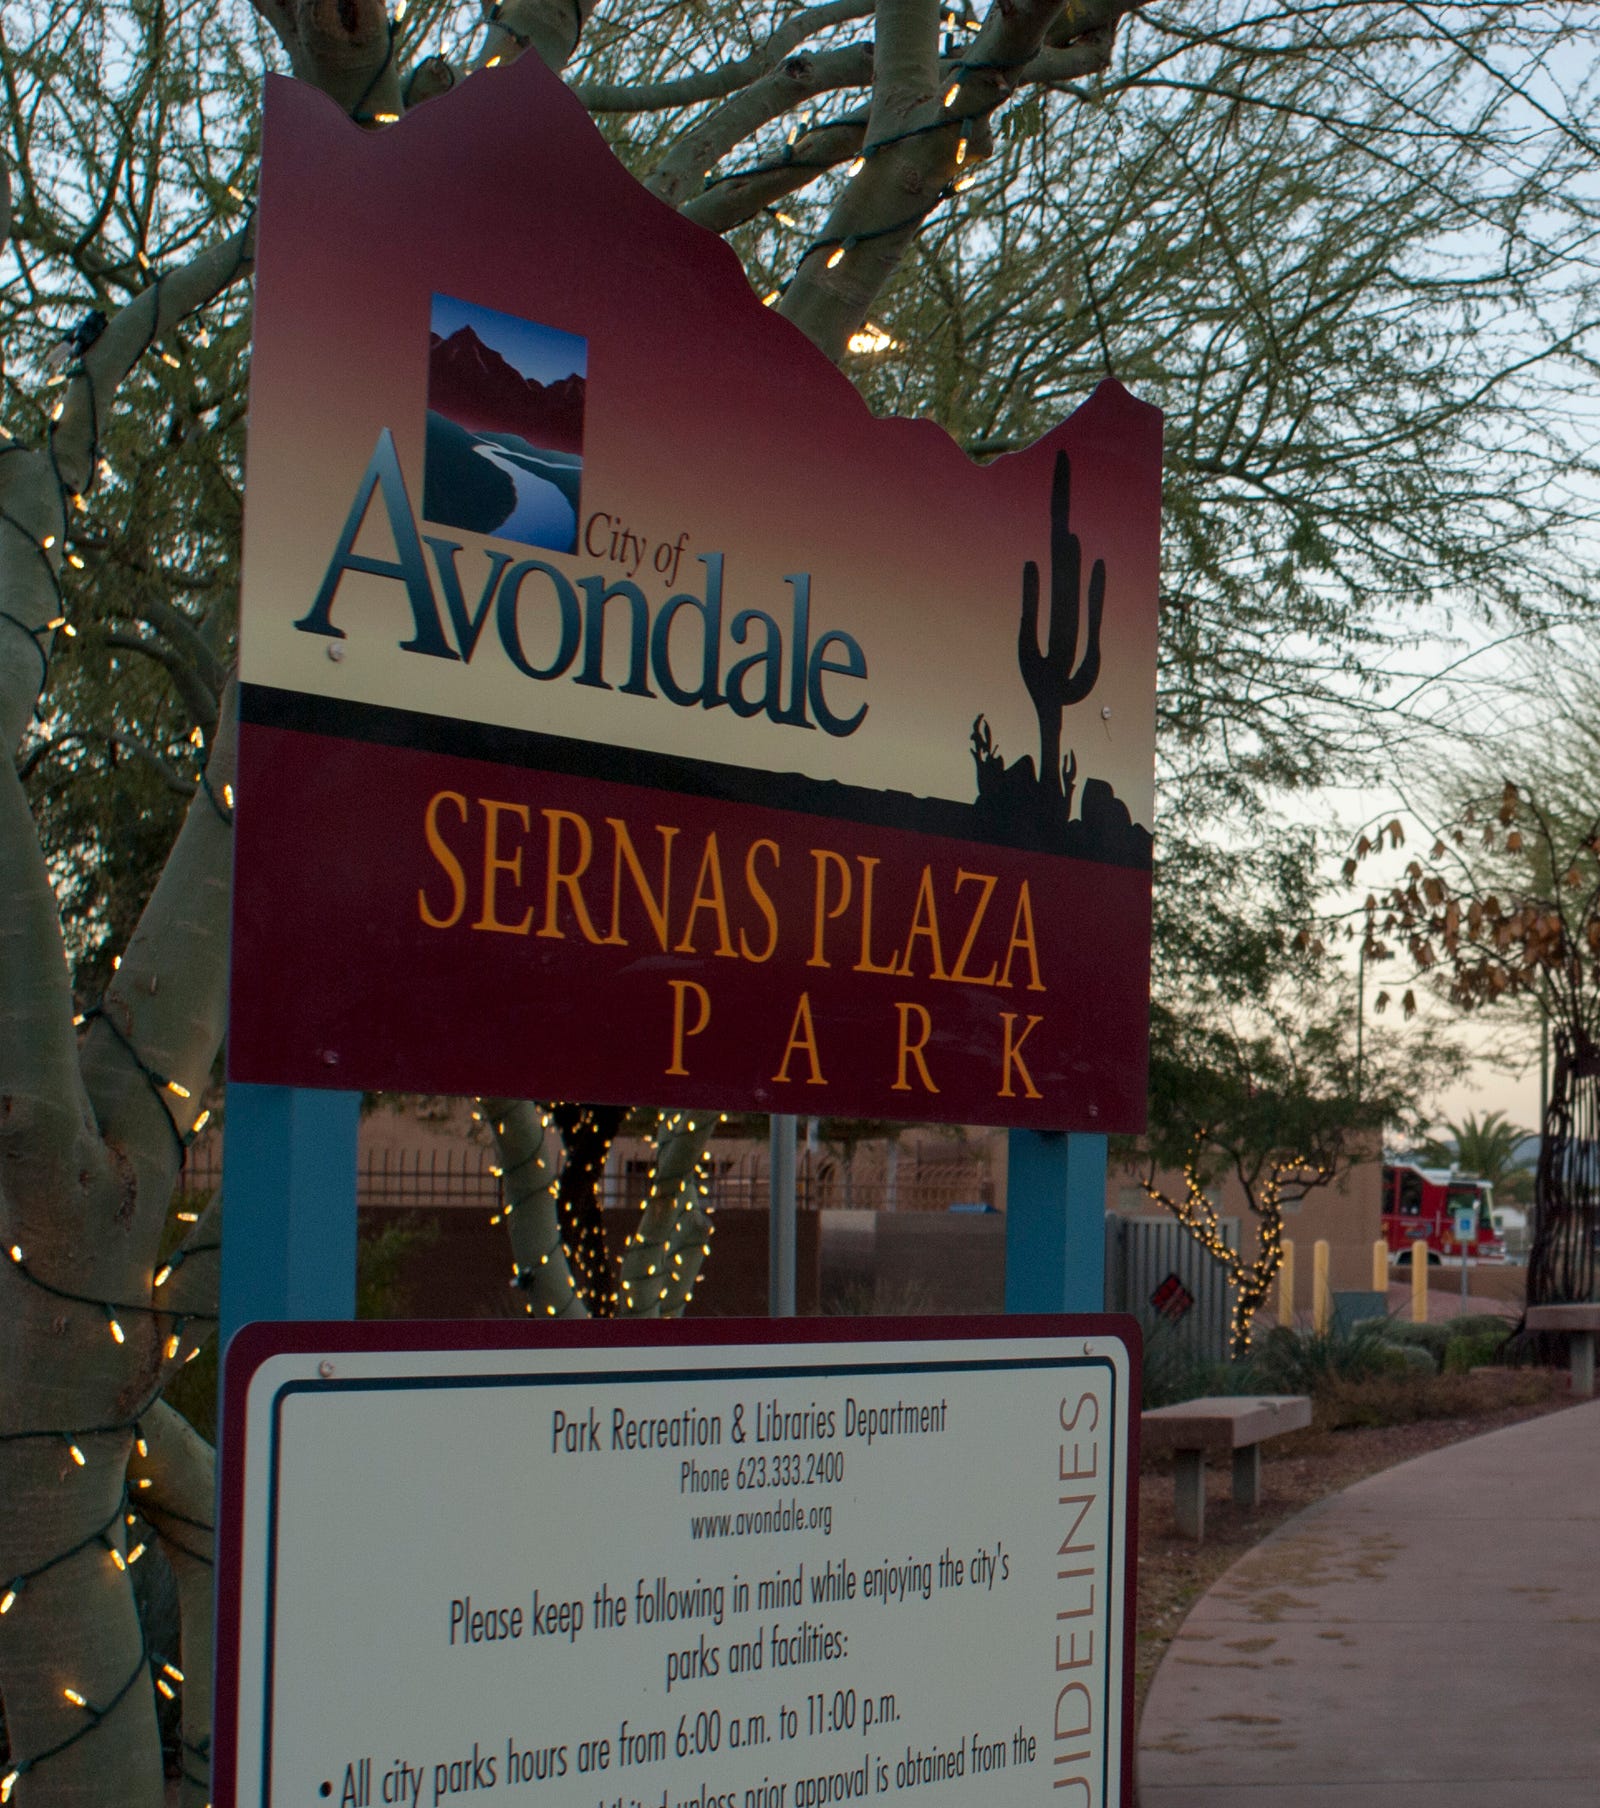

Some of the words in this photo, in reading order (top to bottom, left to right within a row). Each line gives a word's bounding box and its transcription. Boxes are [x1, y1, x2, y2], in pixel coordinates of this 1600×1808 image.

[294, 427, 869, 738] Avondale
[585, 512, 646, 577] City
[654, 533, 689, 587] of
[418, 790, 780, 964] SERNAS
[808, 850, 1047, 992] PLAZA
[552, 1406, 601, 1454] Park
[611, 1407, 722, 1451] Recreation
[731, 1402, 747, 1445] &
[756, 1398, 836, 1443] Libraries
[844, 1397, 948, 1446] Department
[680, 1458, 730, 1494] Phone
[736, 1450, 844, 1490] 623.333.2400
[690, 1497, 833, 1541] www.avondale.org
[449, 1596, 523, 1646] Please
[532, 1589, 584, 1644] keep
[592, 1582, 627, 1630] the
[634, 1576, 725, 1626] following
[733, 1574, 750, 1614] in
[757, 1562, 804, 1611] mind
[810, 1558, 857, 1604] while
[863, 1555, 932, 1605] enjoying
[938, 1546, 964, 1589] the
[970, 1541, 1010, 1591] city's
[666, 1633, 720, 1694] parks
[728, 1626, 764, 1674] and
[770, 1620, 849, 1668] facilities:
[340, 1757, 371, 1808] All
[381, 1758, 425, 1808] city
[433, 1742, 497, 1808] parks
[507, 1737, 568, 1785] hours
[577, 1739, 611, 1774] are
[618, 1720, 666, 1767] from
[675, 1709, 721, 1758] 6:00
[729, 1715, 771, 1749] a.m.
[779, 1704, 798, 1741] to
[807, 1688, 857, 1736] 11:00
[862, 1694, 901, 1737] p.m.
[794, 1753, 869, 1808] approval
[876, 1756, 889, 1793] is
[896, 1735, 966, 1789] obtained
[970, 1732, 1007, 1774] from
[1012, 1725, 1037, 1766] the
